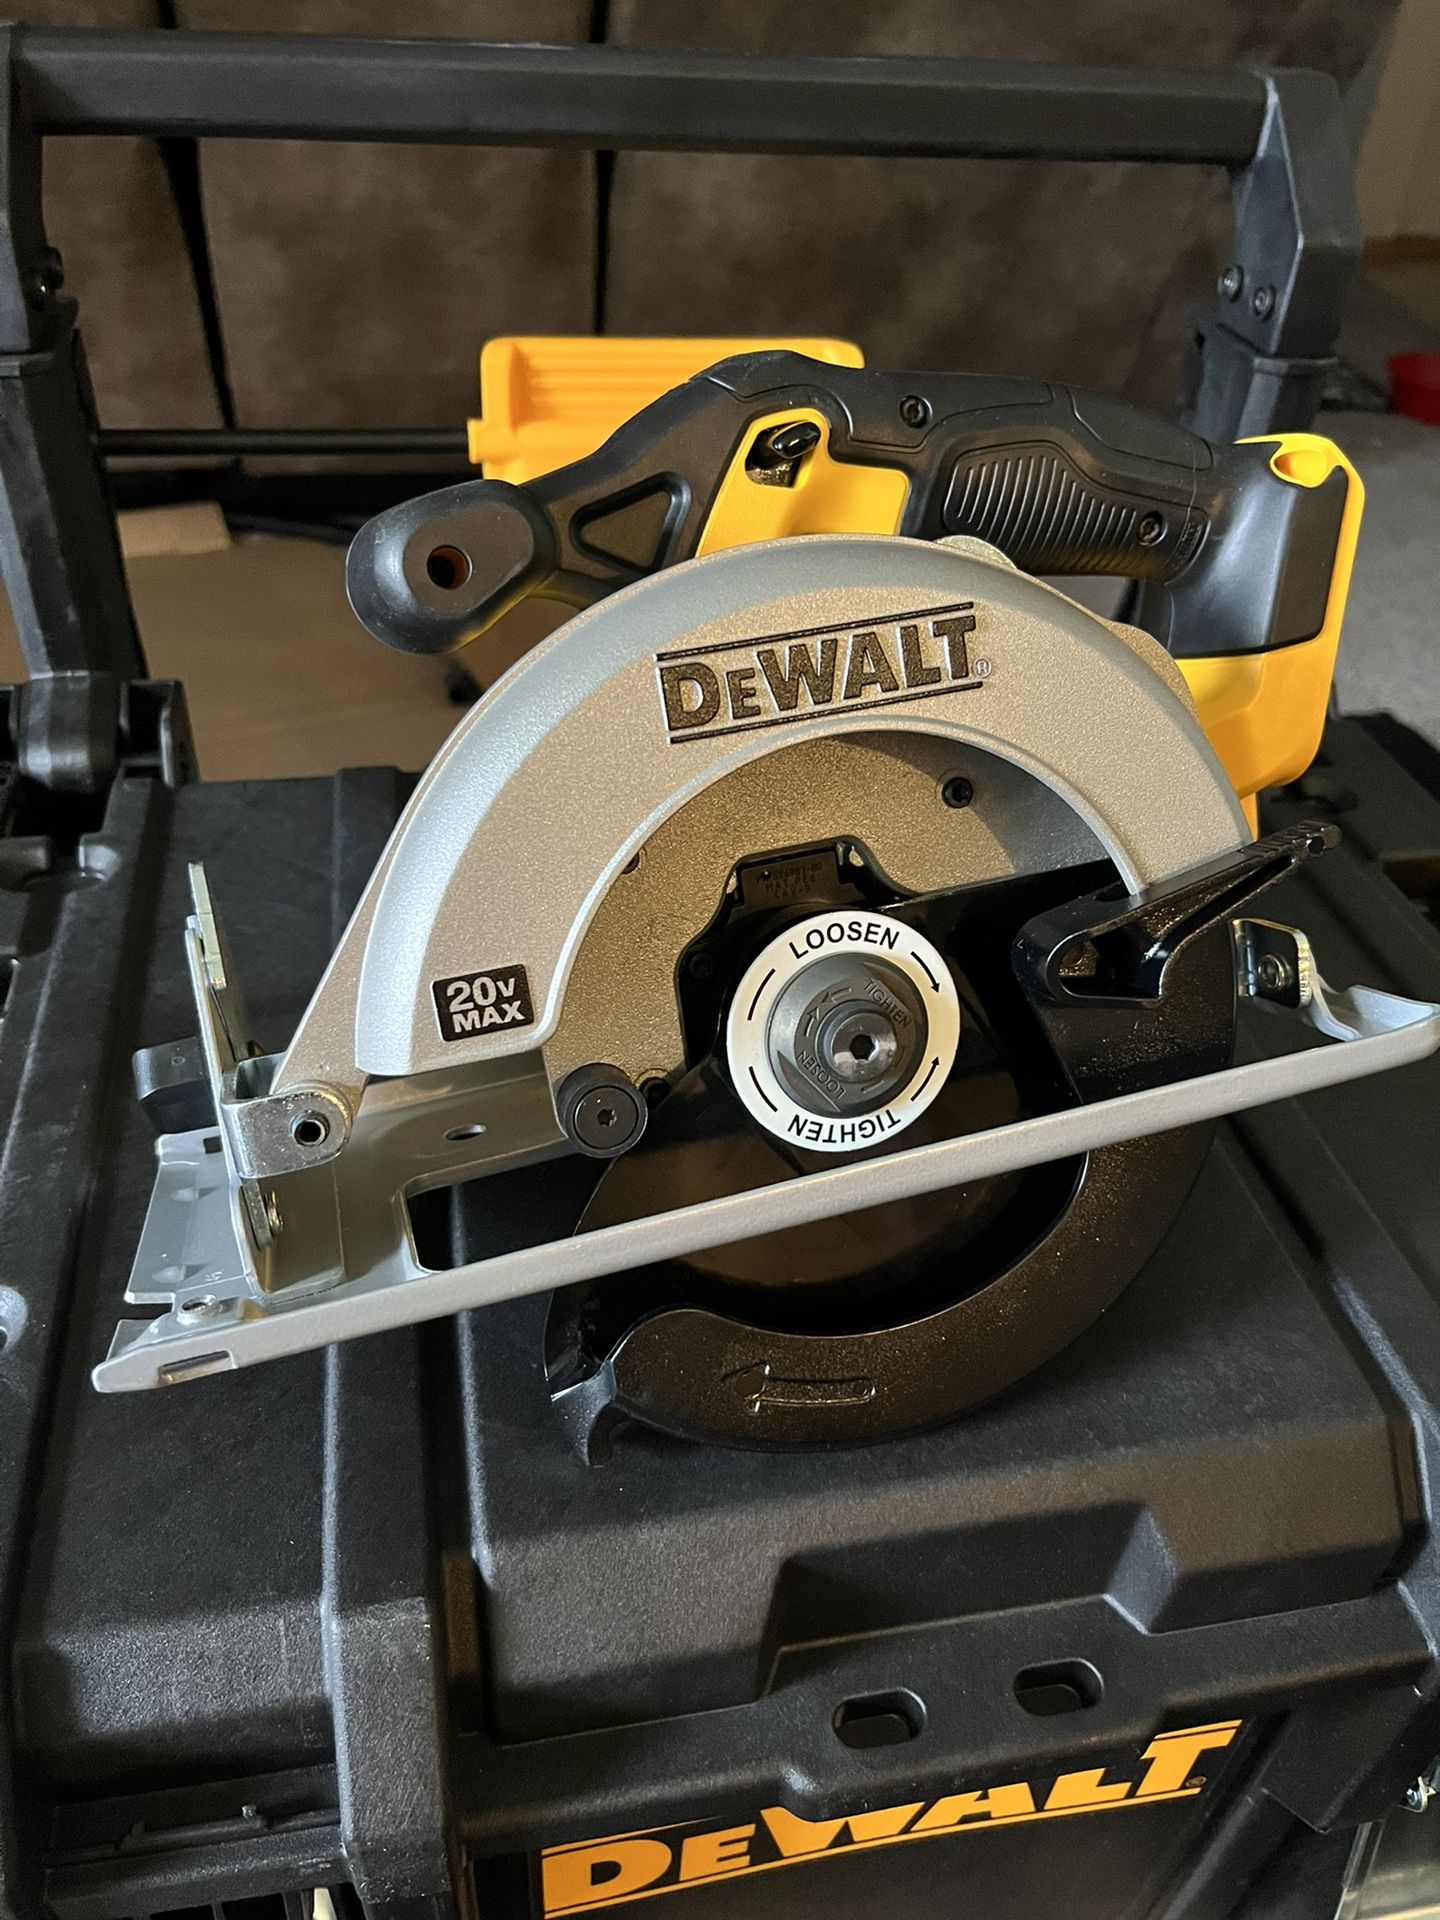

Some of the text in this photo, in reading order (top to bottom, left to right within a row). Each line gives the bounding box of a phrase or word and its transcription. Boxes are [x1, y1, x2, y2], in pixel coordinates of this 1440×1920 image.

[788, 920, 900, 960] LOOSEN
[451, 1000, 526, 1033] MAX
[863, 977, 913, 1028] TIGHTEN
[796, 1049, 847, 1100] LOOSEN
[787, 1108, 902, 1144] TIGHTEN
